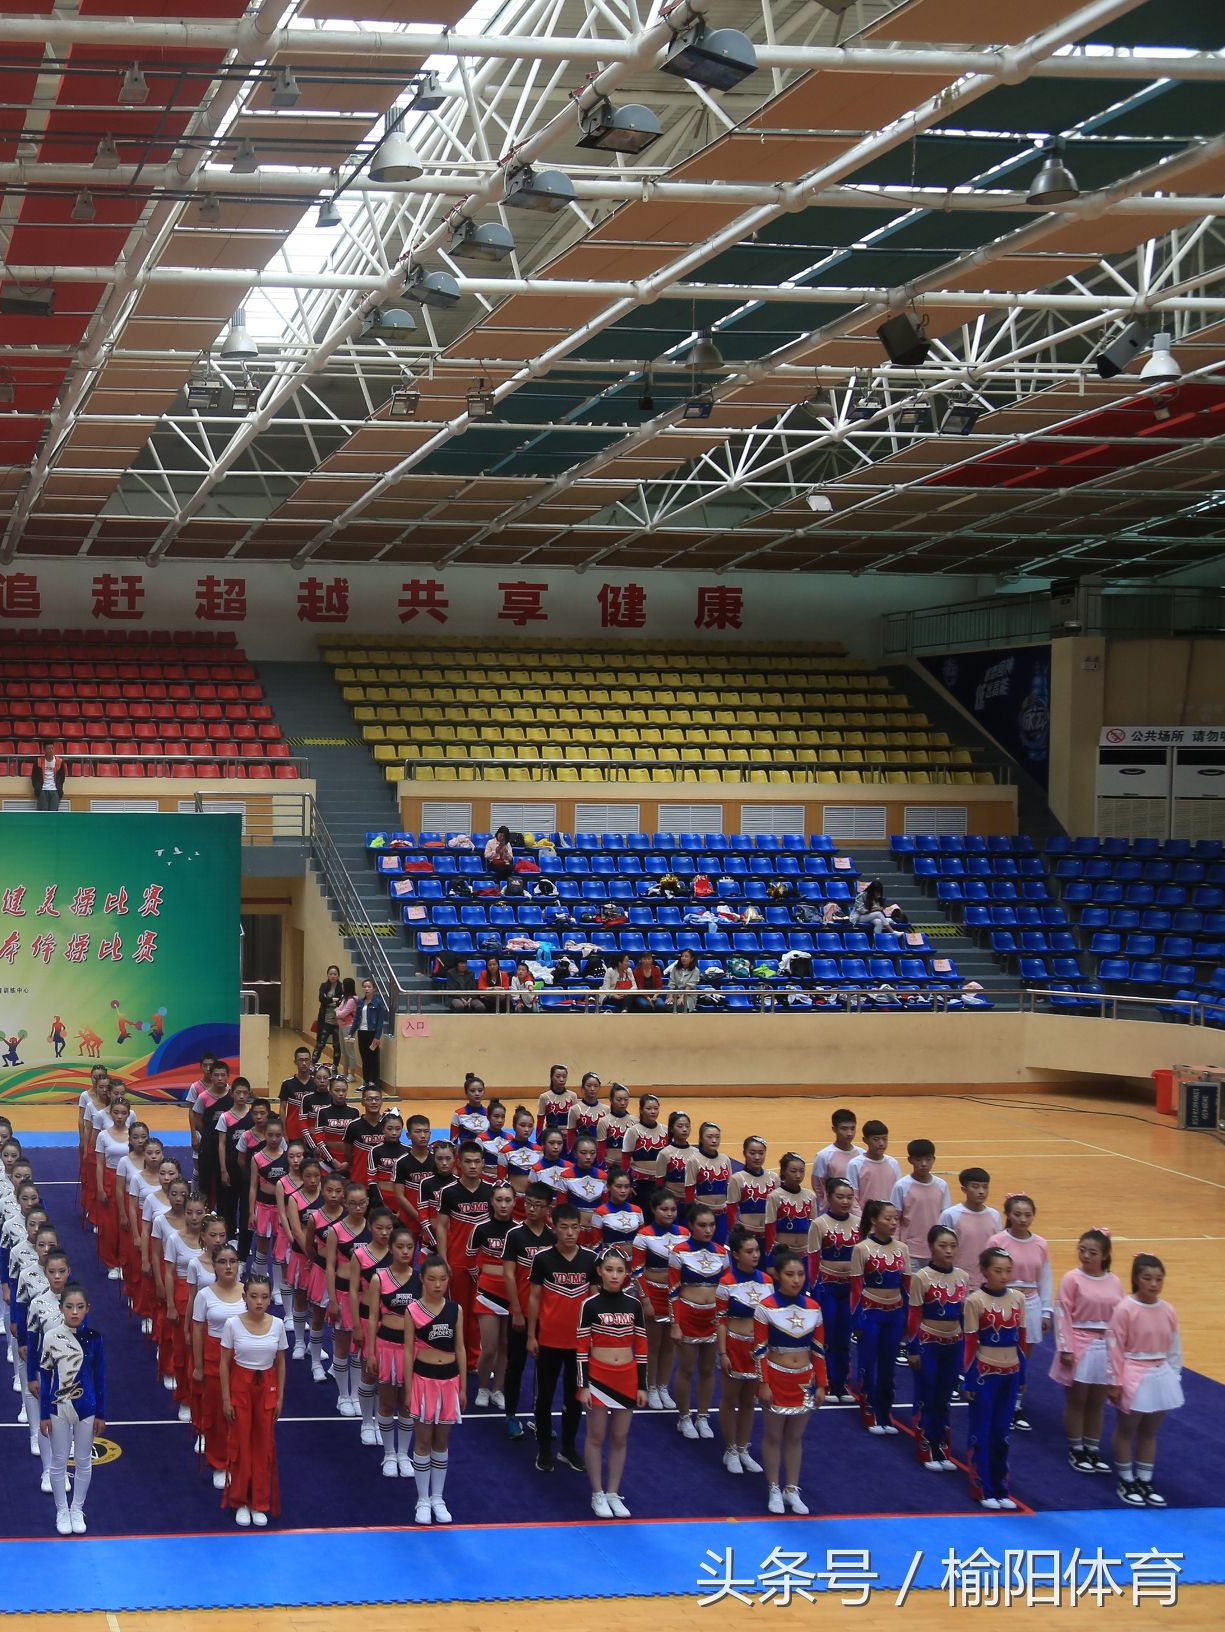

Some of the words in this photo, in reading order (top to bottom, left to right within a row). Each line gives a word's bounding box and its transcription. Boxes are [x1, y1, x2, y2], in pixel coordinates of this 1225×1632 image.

[1130, 730, 1184, 742] 公共场所
[406, 1021, 425, 1030] 入口
[553, 1272, 587, 1284] YDJMC
[598, 1313, 635, 1325] YDJMC
